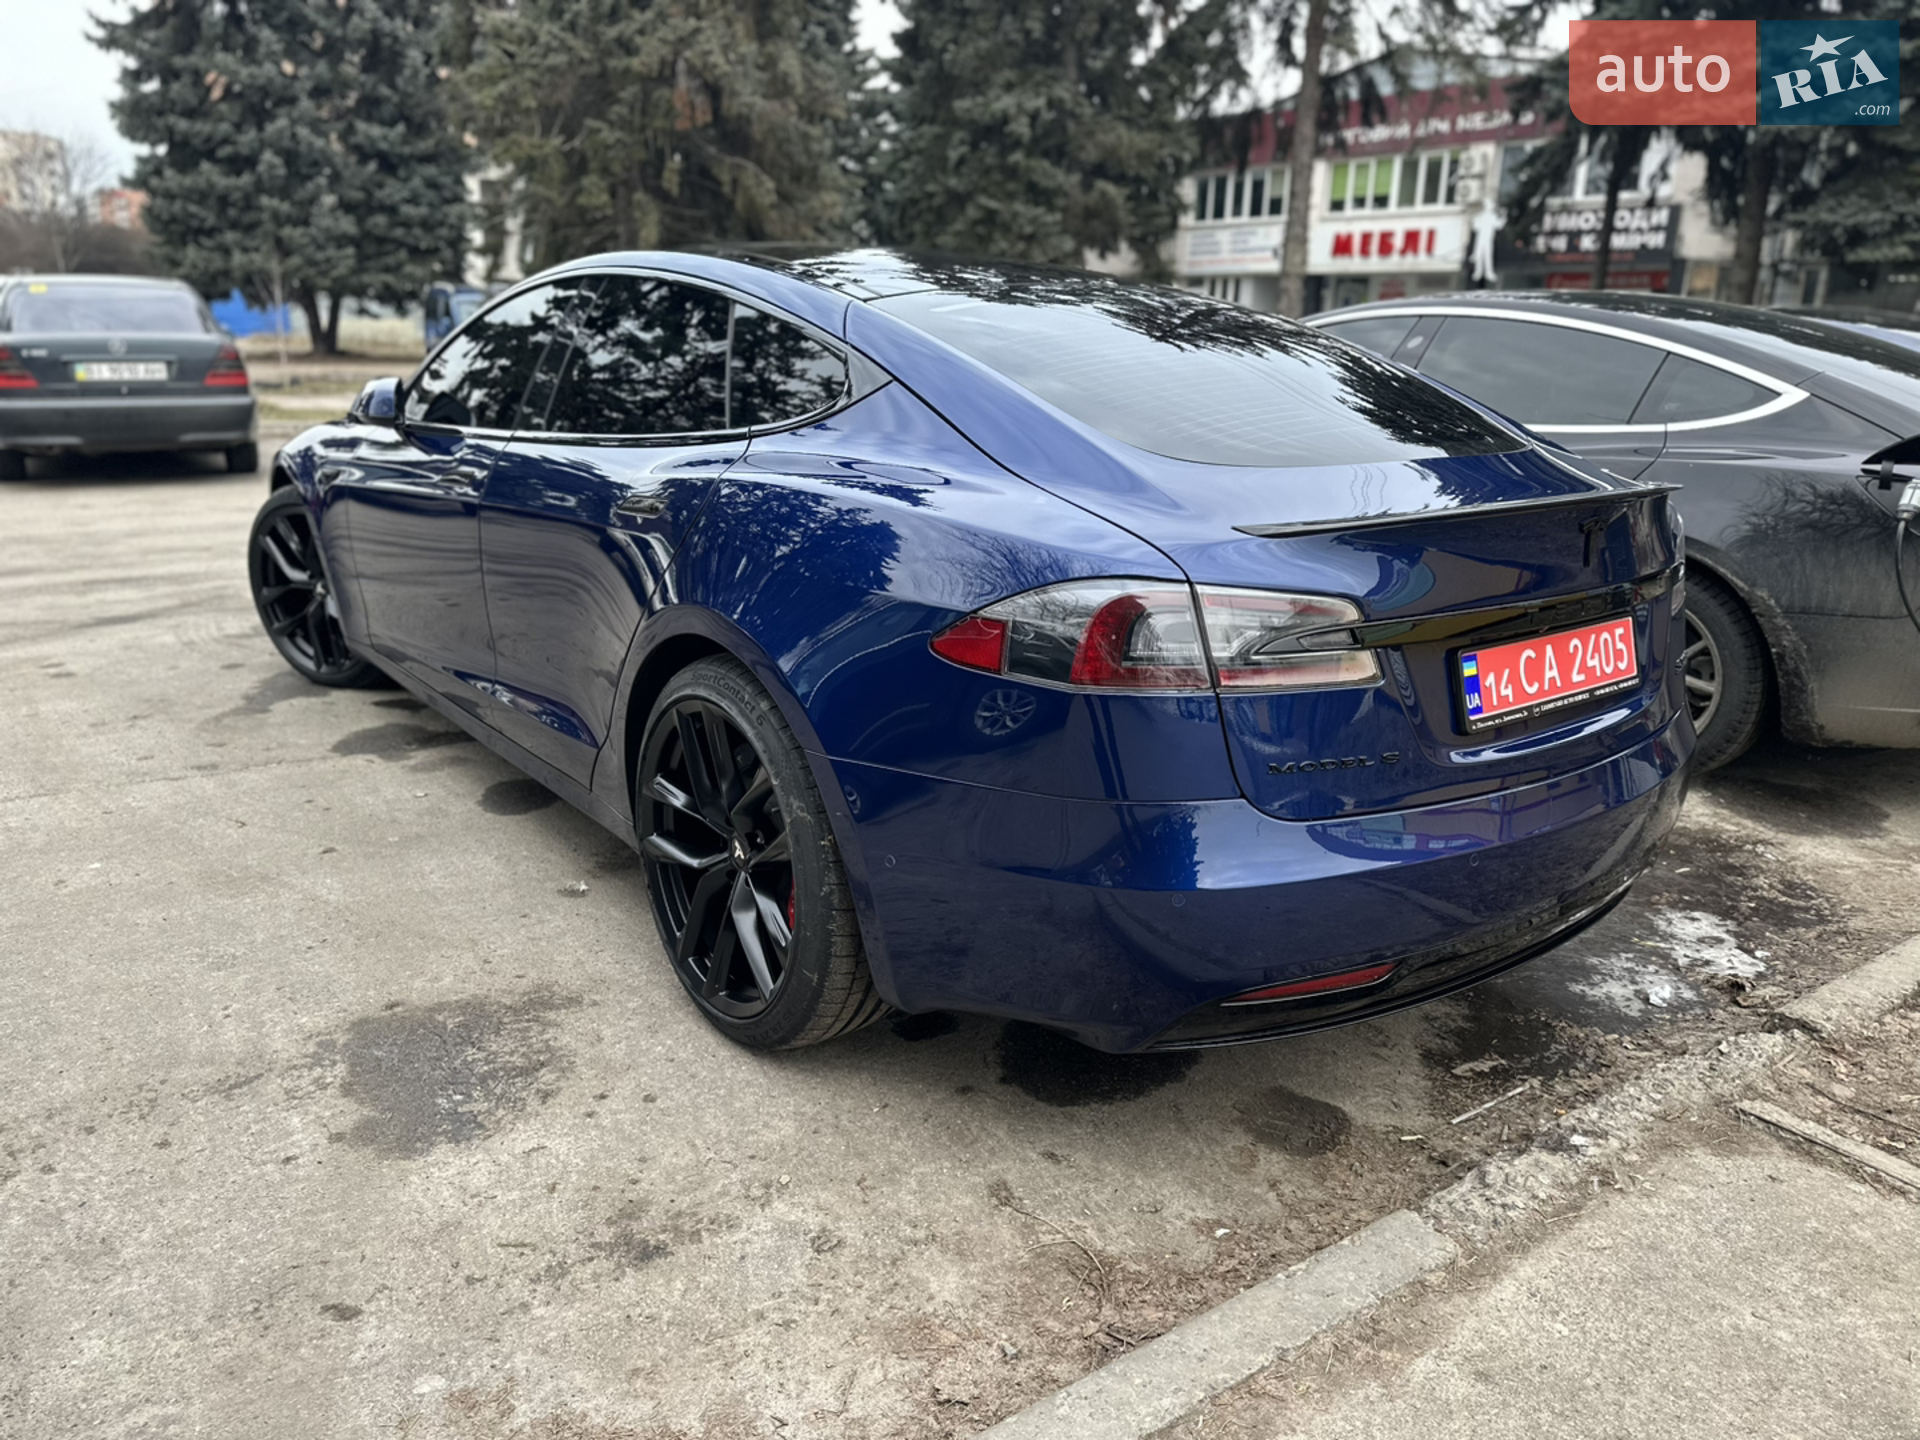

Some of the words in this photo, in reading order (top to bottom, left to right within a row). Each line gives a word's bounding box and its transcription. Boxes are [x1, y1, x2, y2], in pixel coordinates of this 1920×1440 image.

[1331, 228, 1436, 258] МЕБЛІ
[1485, 667, 1513, 706] 14
[1519, 644, 1562, 695] CA
[1569, 626, 1629, 684] 2405
[690, 671, 756, 715] SportContact
[755, 714, 766, 727] 6
[1466, 692, 1481, 709] UA
[1267, 755, 1375, 774] MODEL
[1380, 751, 1400, 764] S
